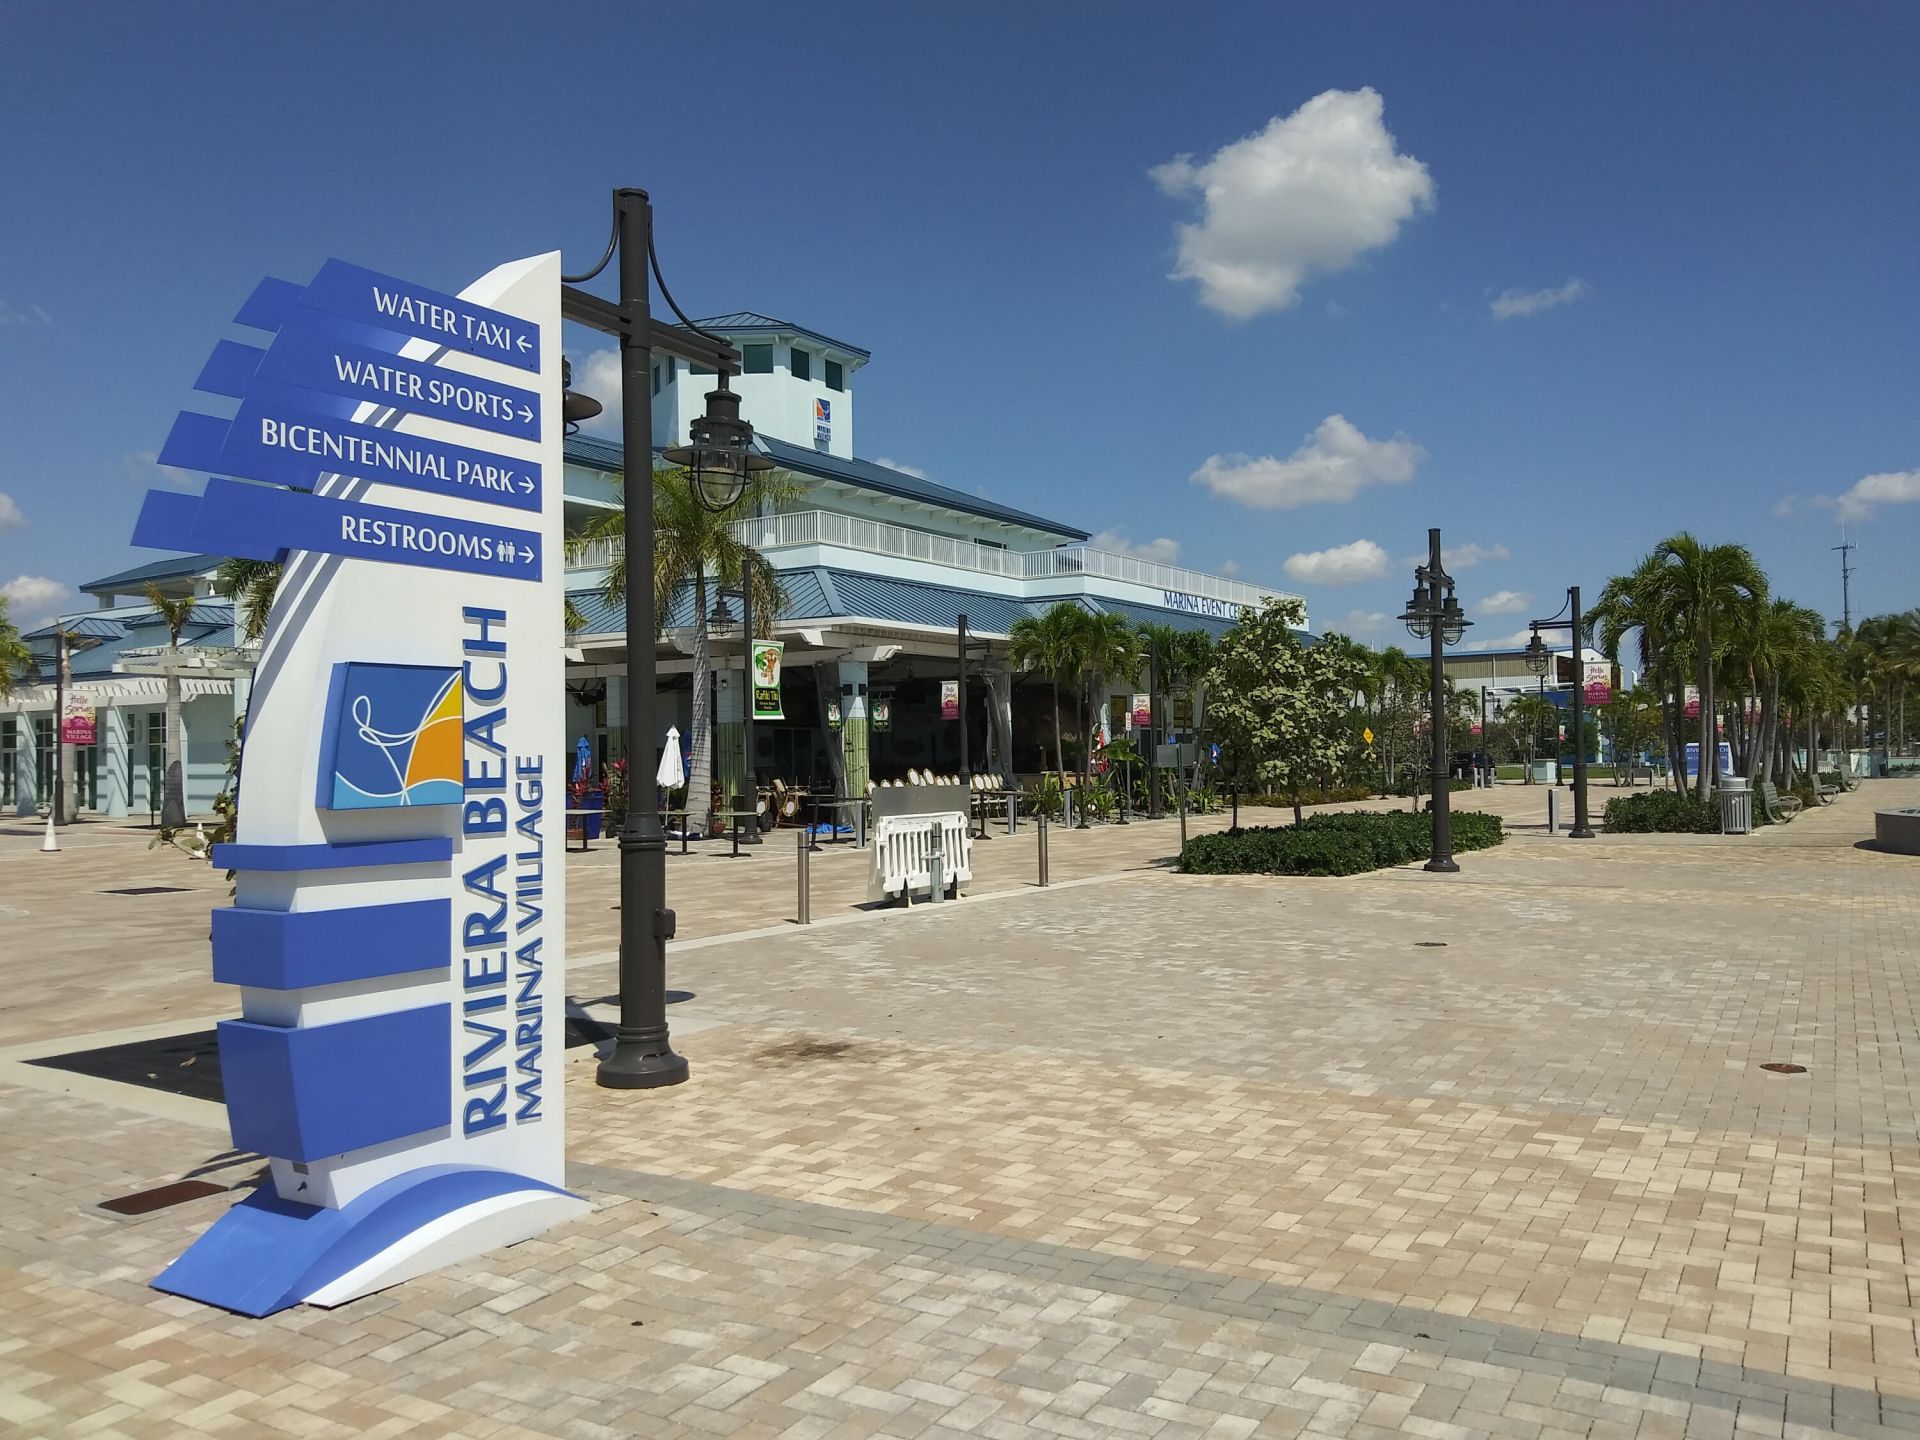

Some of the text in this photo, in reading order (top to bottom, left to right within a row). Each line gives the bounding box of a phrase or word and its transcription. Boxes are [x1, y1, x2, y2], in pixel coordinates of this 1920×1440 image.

[372, 286, 512, 352] WATER TAXI
[334, 354, 514, 422] WATER SPORTS
[261, 417, 516, 495] BICENTENNIAL PARK
[341, 514, 493, 561] RESTROOMS
[1164, 589, 1200, 613] MARINA
[1201, 597, 1227, 617] EVENT
[462, 605, 508, 1140] RIVIERA BEACH
[514, 753, 544, 1127] MARINA VILLAGE
